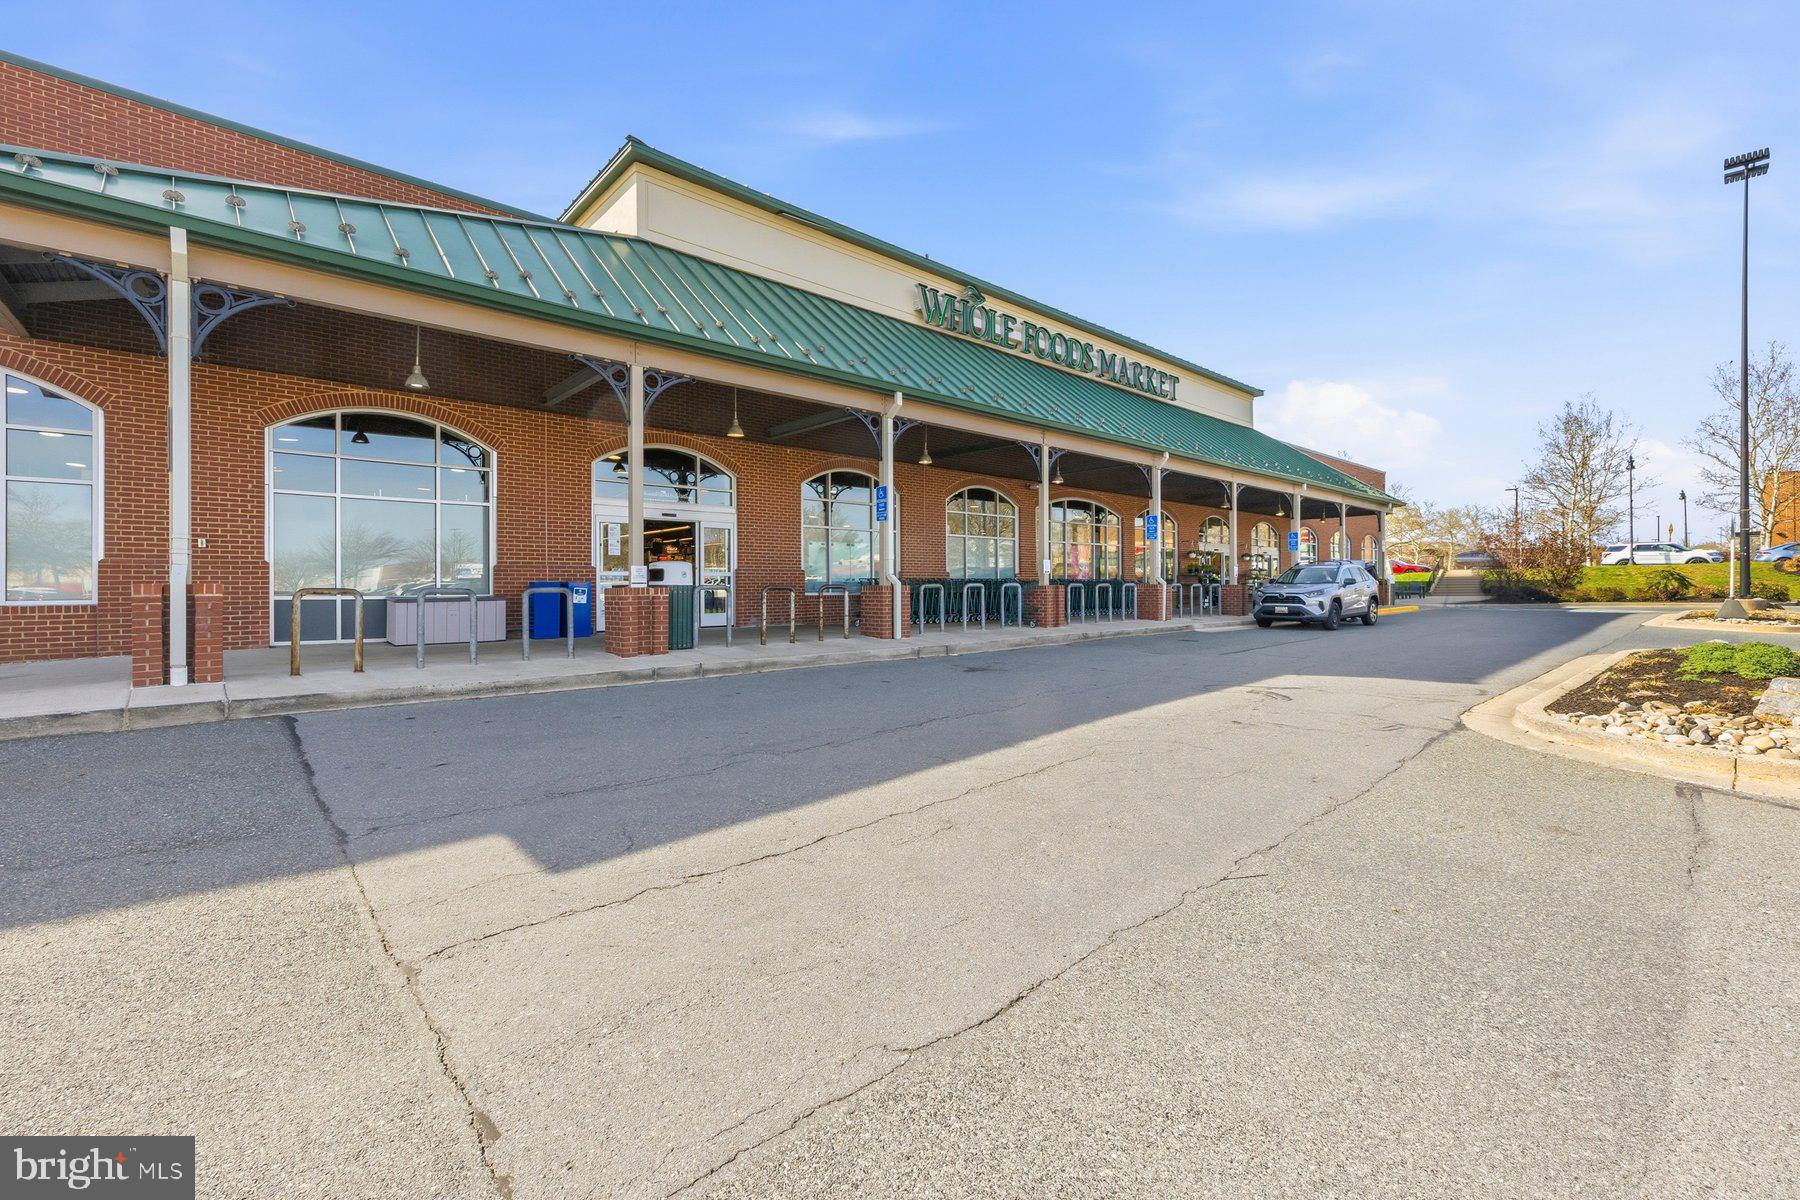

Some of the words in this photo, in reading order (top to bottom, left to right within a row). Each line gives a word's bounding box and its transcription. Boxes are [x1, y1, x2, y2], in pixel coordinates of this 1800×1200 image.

[915, 283, 1017, 350] WHOLE
[1021, 321, 1094, 373] FOODS
[1097, 349, 1180, 401] MARKET
